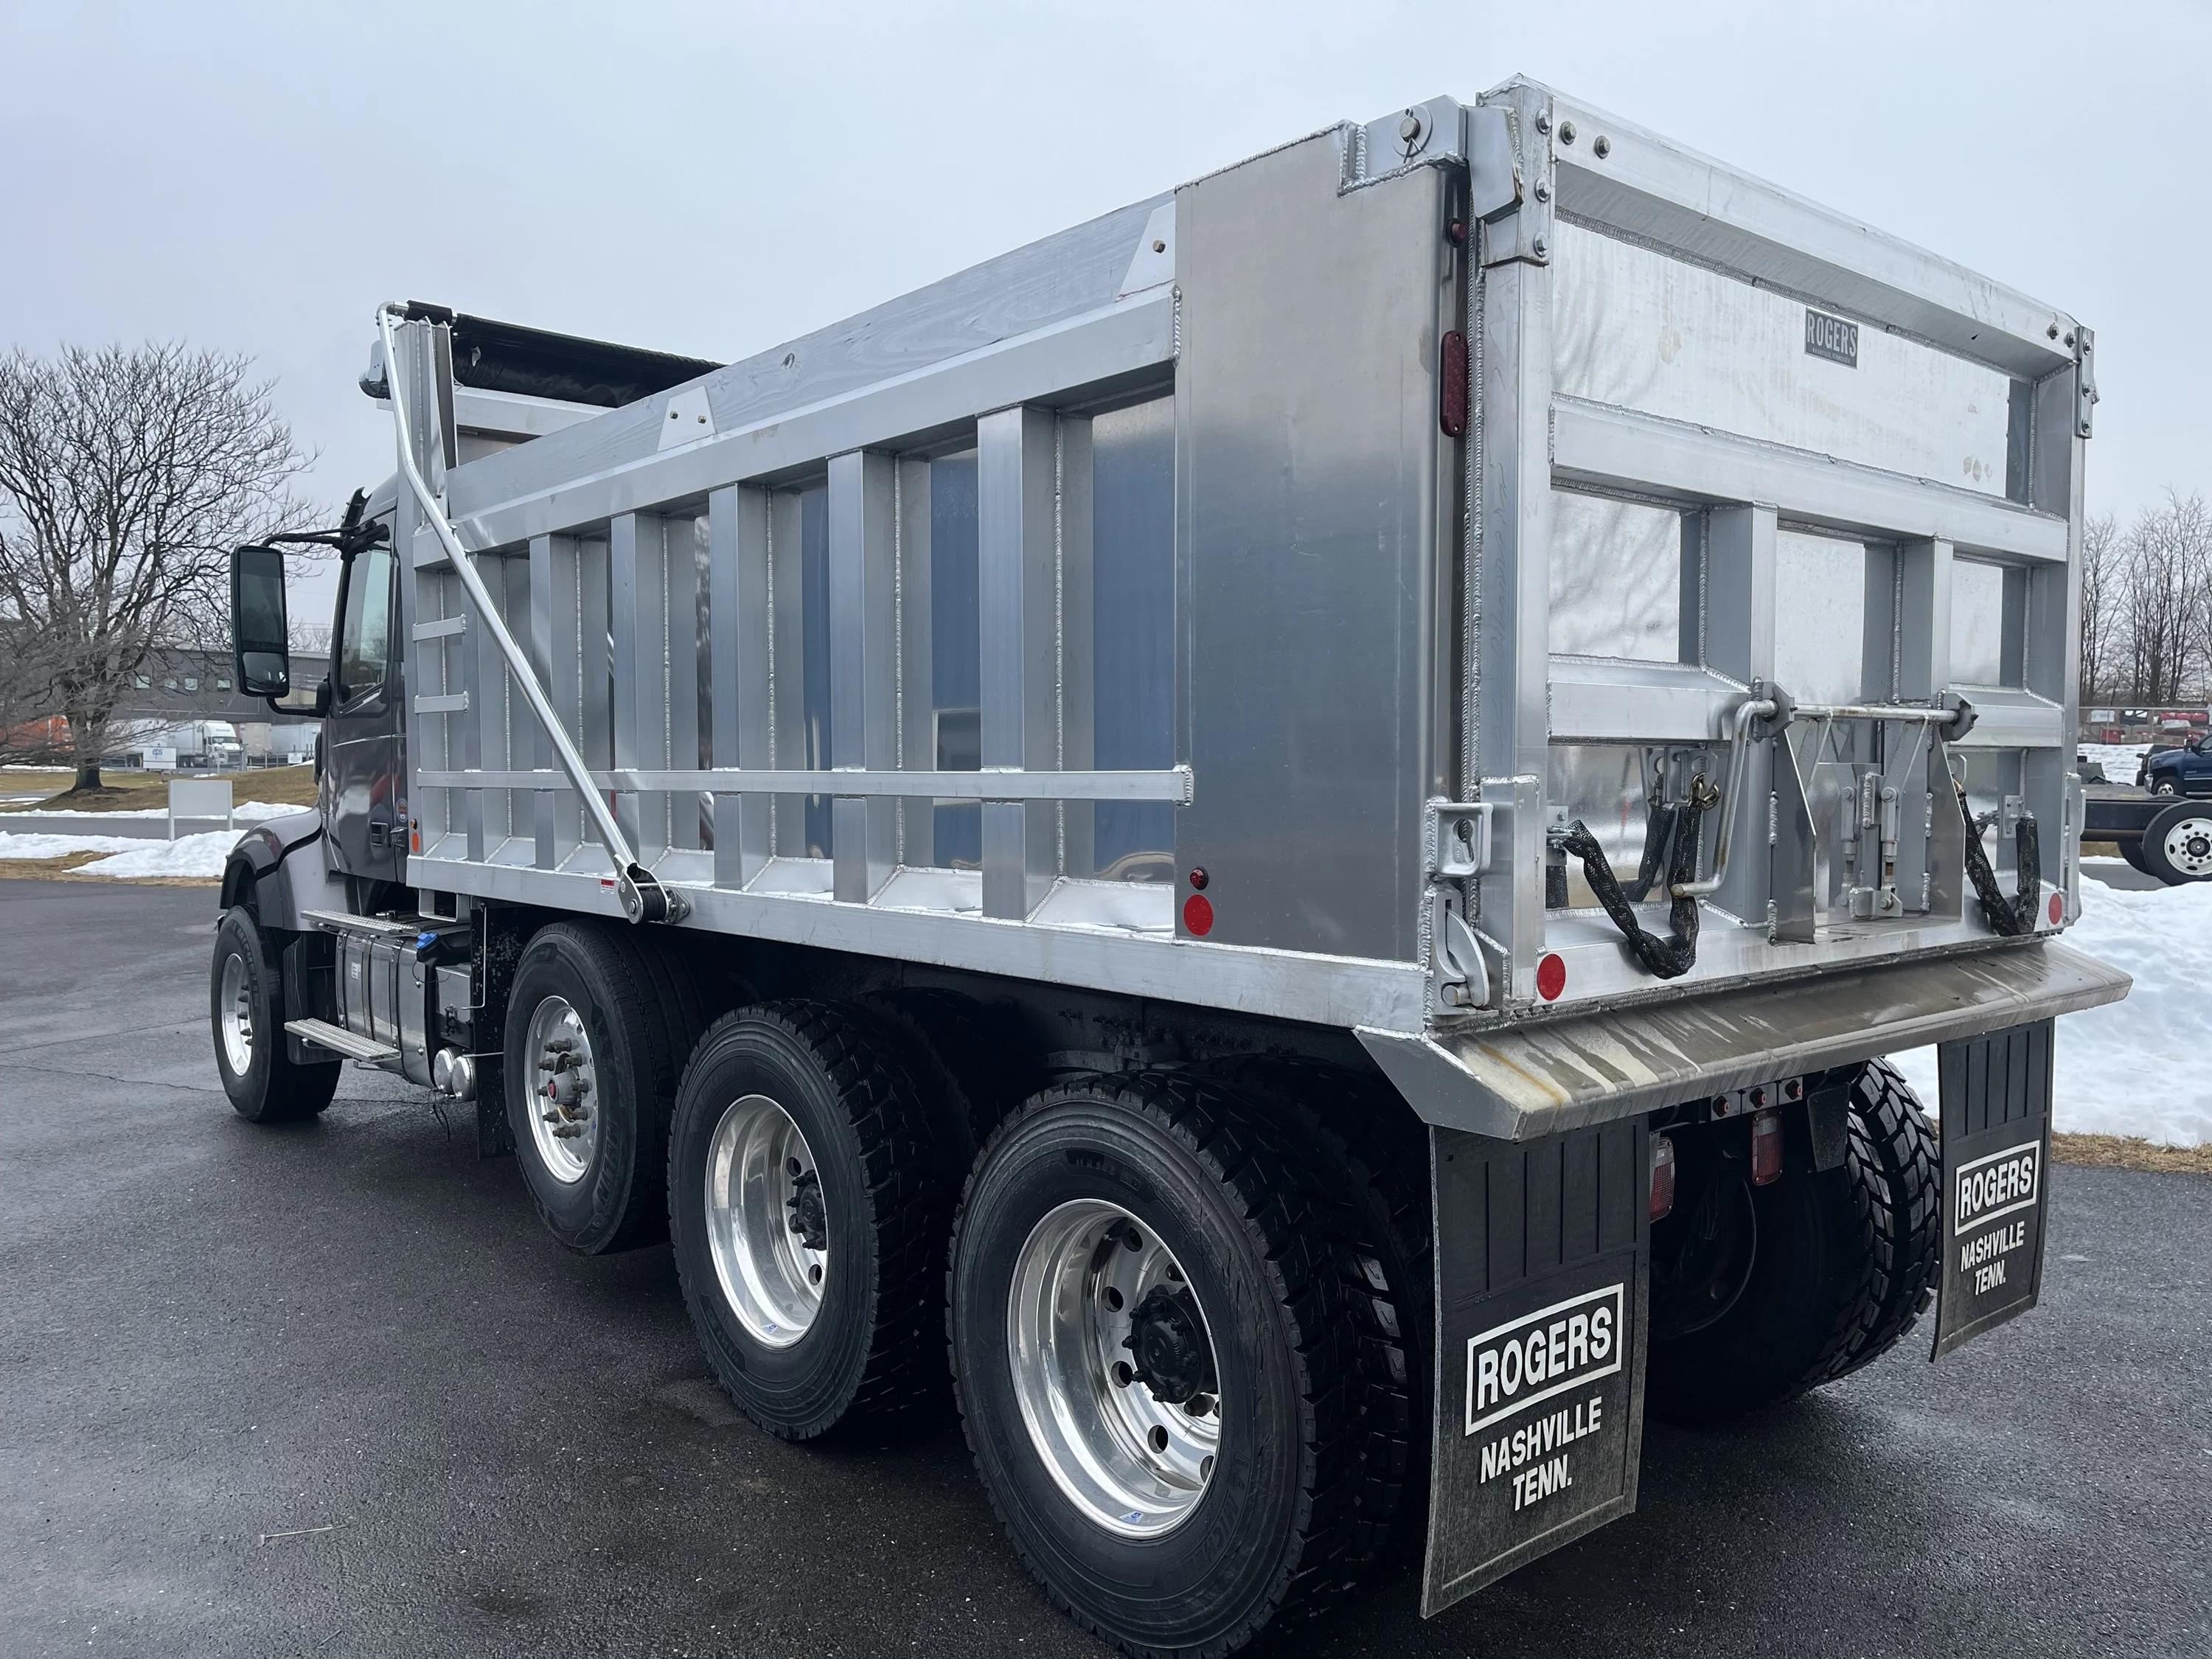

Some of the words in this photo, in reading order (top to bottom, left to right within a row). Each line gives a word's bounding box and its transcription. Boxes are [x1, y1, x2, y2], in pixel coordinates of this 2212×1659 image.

[1806, 312, 1857, 358] ROGERS
[1960, 1155, 2033, 1220] ROGERS
[1961, 1220, 2025, 1273] NASHVILLE
[1975, 1259, 2006, 1295] TENN.
[1477, 1306, 1613, 1411] ROGERS
[1480, 1396, 1603, 1484] NASHVILLE
[1512, 1453, 1573, 1512] TENN.
